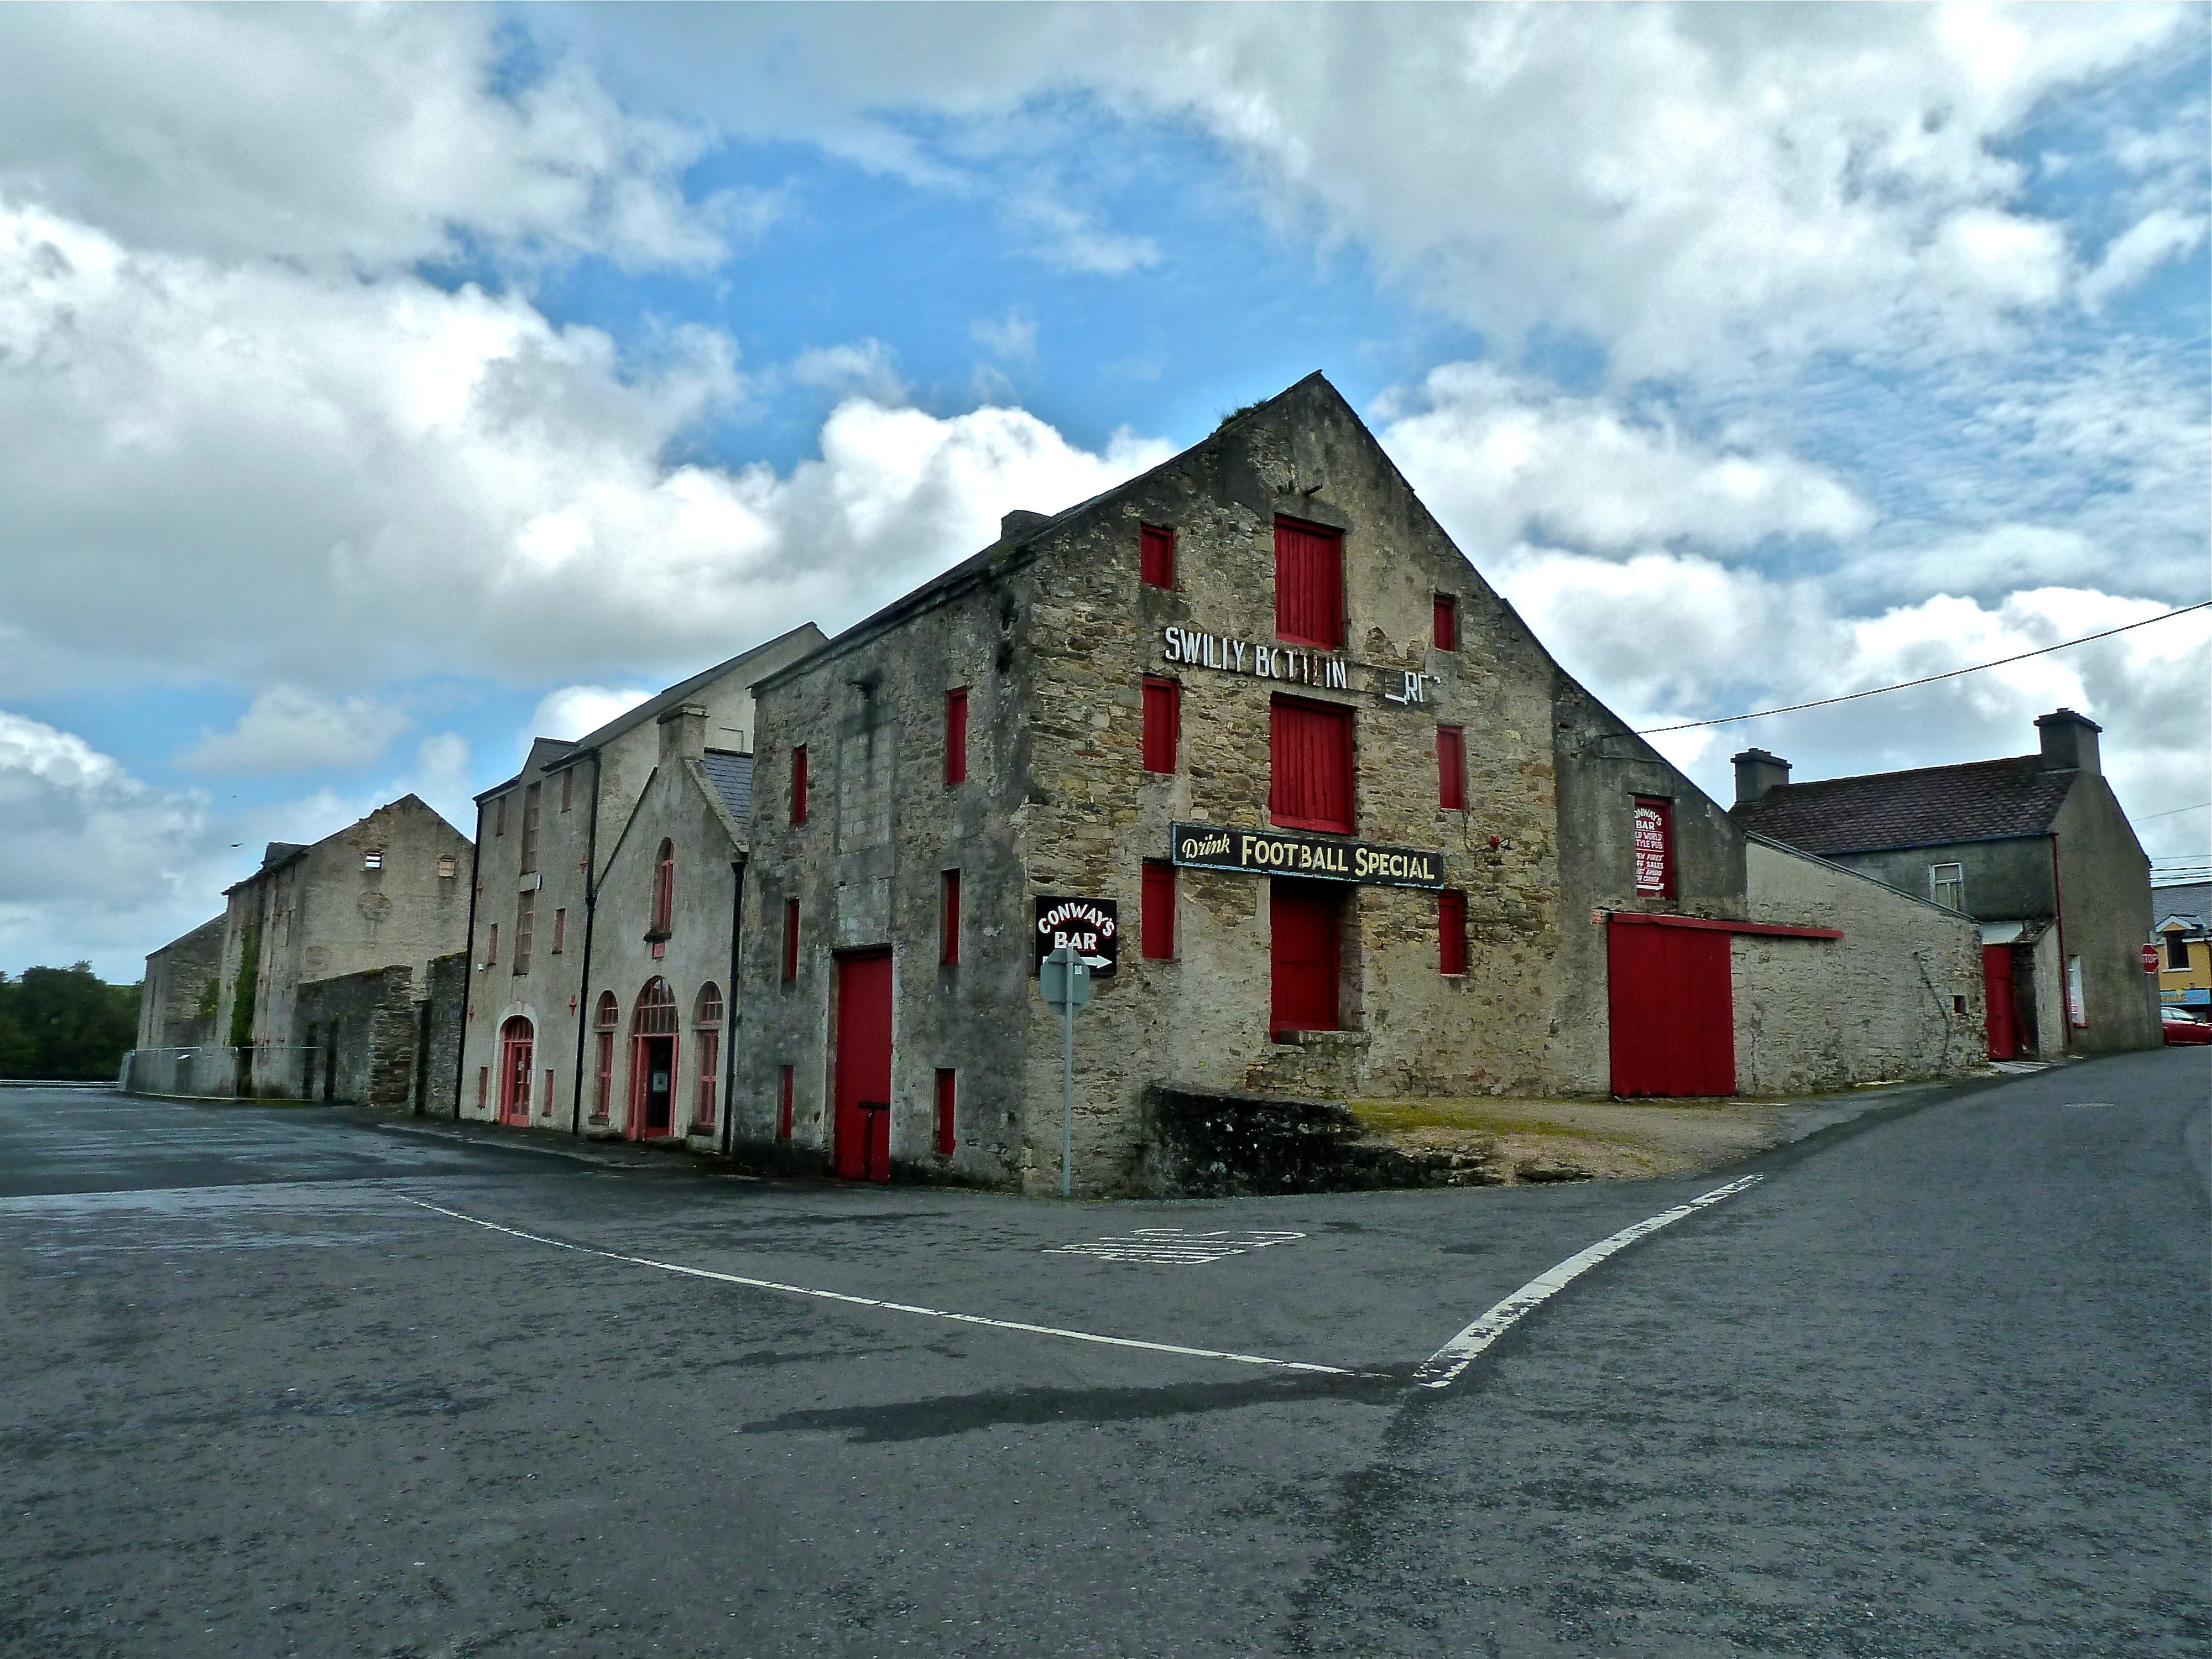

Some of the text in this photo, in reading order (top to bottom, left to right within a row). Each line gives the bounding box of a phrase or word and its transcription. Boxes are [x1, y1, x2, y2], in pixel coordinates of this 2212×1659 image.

[1635, 820, 1655, 831] BAR
[1635, 839, 1651, 848] TYLE
[1182, 833, 1435, 880] Drink FOOTBALL SPECIAL
[1038, 902, 1115, 937] CONWAY'S
[1055, 931, 1097, 950] BAR
